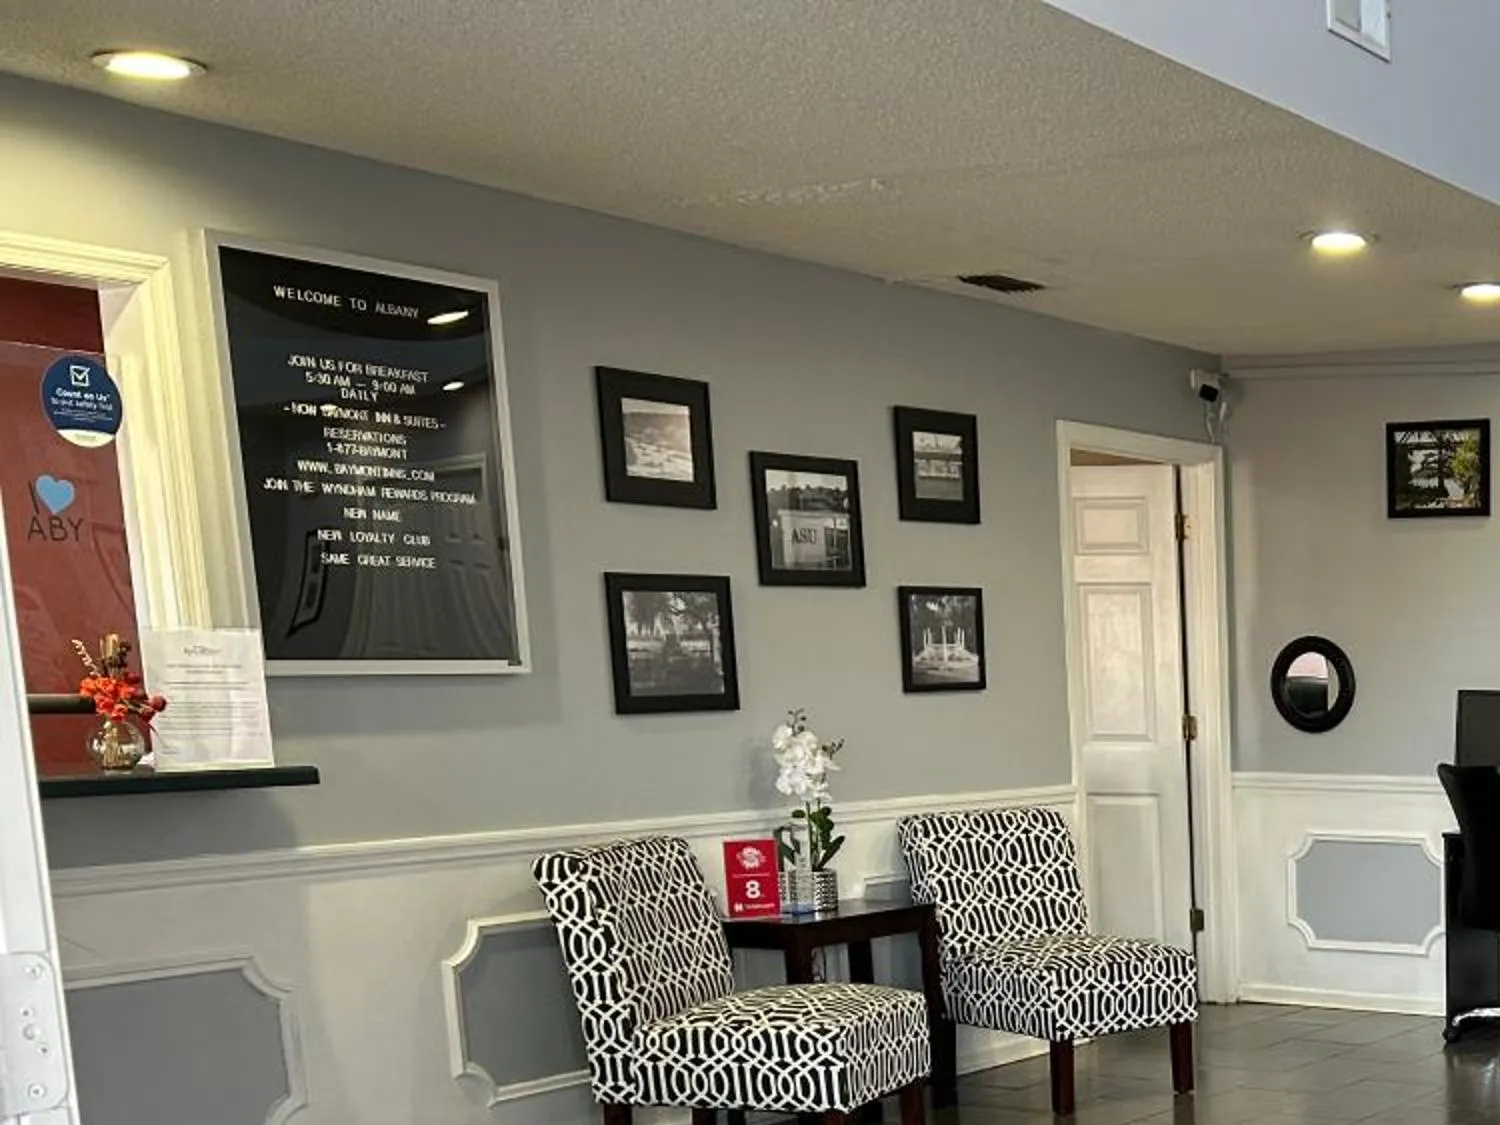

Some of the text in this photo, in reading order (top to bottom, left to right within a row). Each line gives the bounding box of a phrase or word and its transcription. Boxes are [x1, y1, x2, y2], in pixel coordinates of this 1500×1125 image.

[273, 285, 419, 319] WELCOME TO ALBANY
[287, 353, 429, 383] JOIN US FOR BREAKFAST
[333, 374, 351, 387] AM
[400, 383, 416, 395] AM
[341, 388, 379, 402] DAILY
[403, 415, 439, 429] SUITES
[323, 427, 407, 446] RESERVATIONS
[263, 477, 289, 491] JOIN
[291, 480, 316, 493] THE
[321, 482, 376, 497] WYNDHAM
[381, 487, 428, 501] REWARDS
[372, 509, 401, 522] NAME
[27, 515, 83, 542] ABY
[791, 527, 817, 545] ASU
[349, 531, 395, 544] LOYALTY
[403, 534, 431, 546] CLUB
[321, 552, 436, 569] SAME GREAT SERVICE
